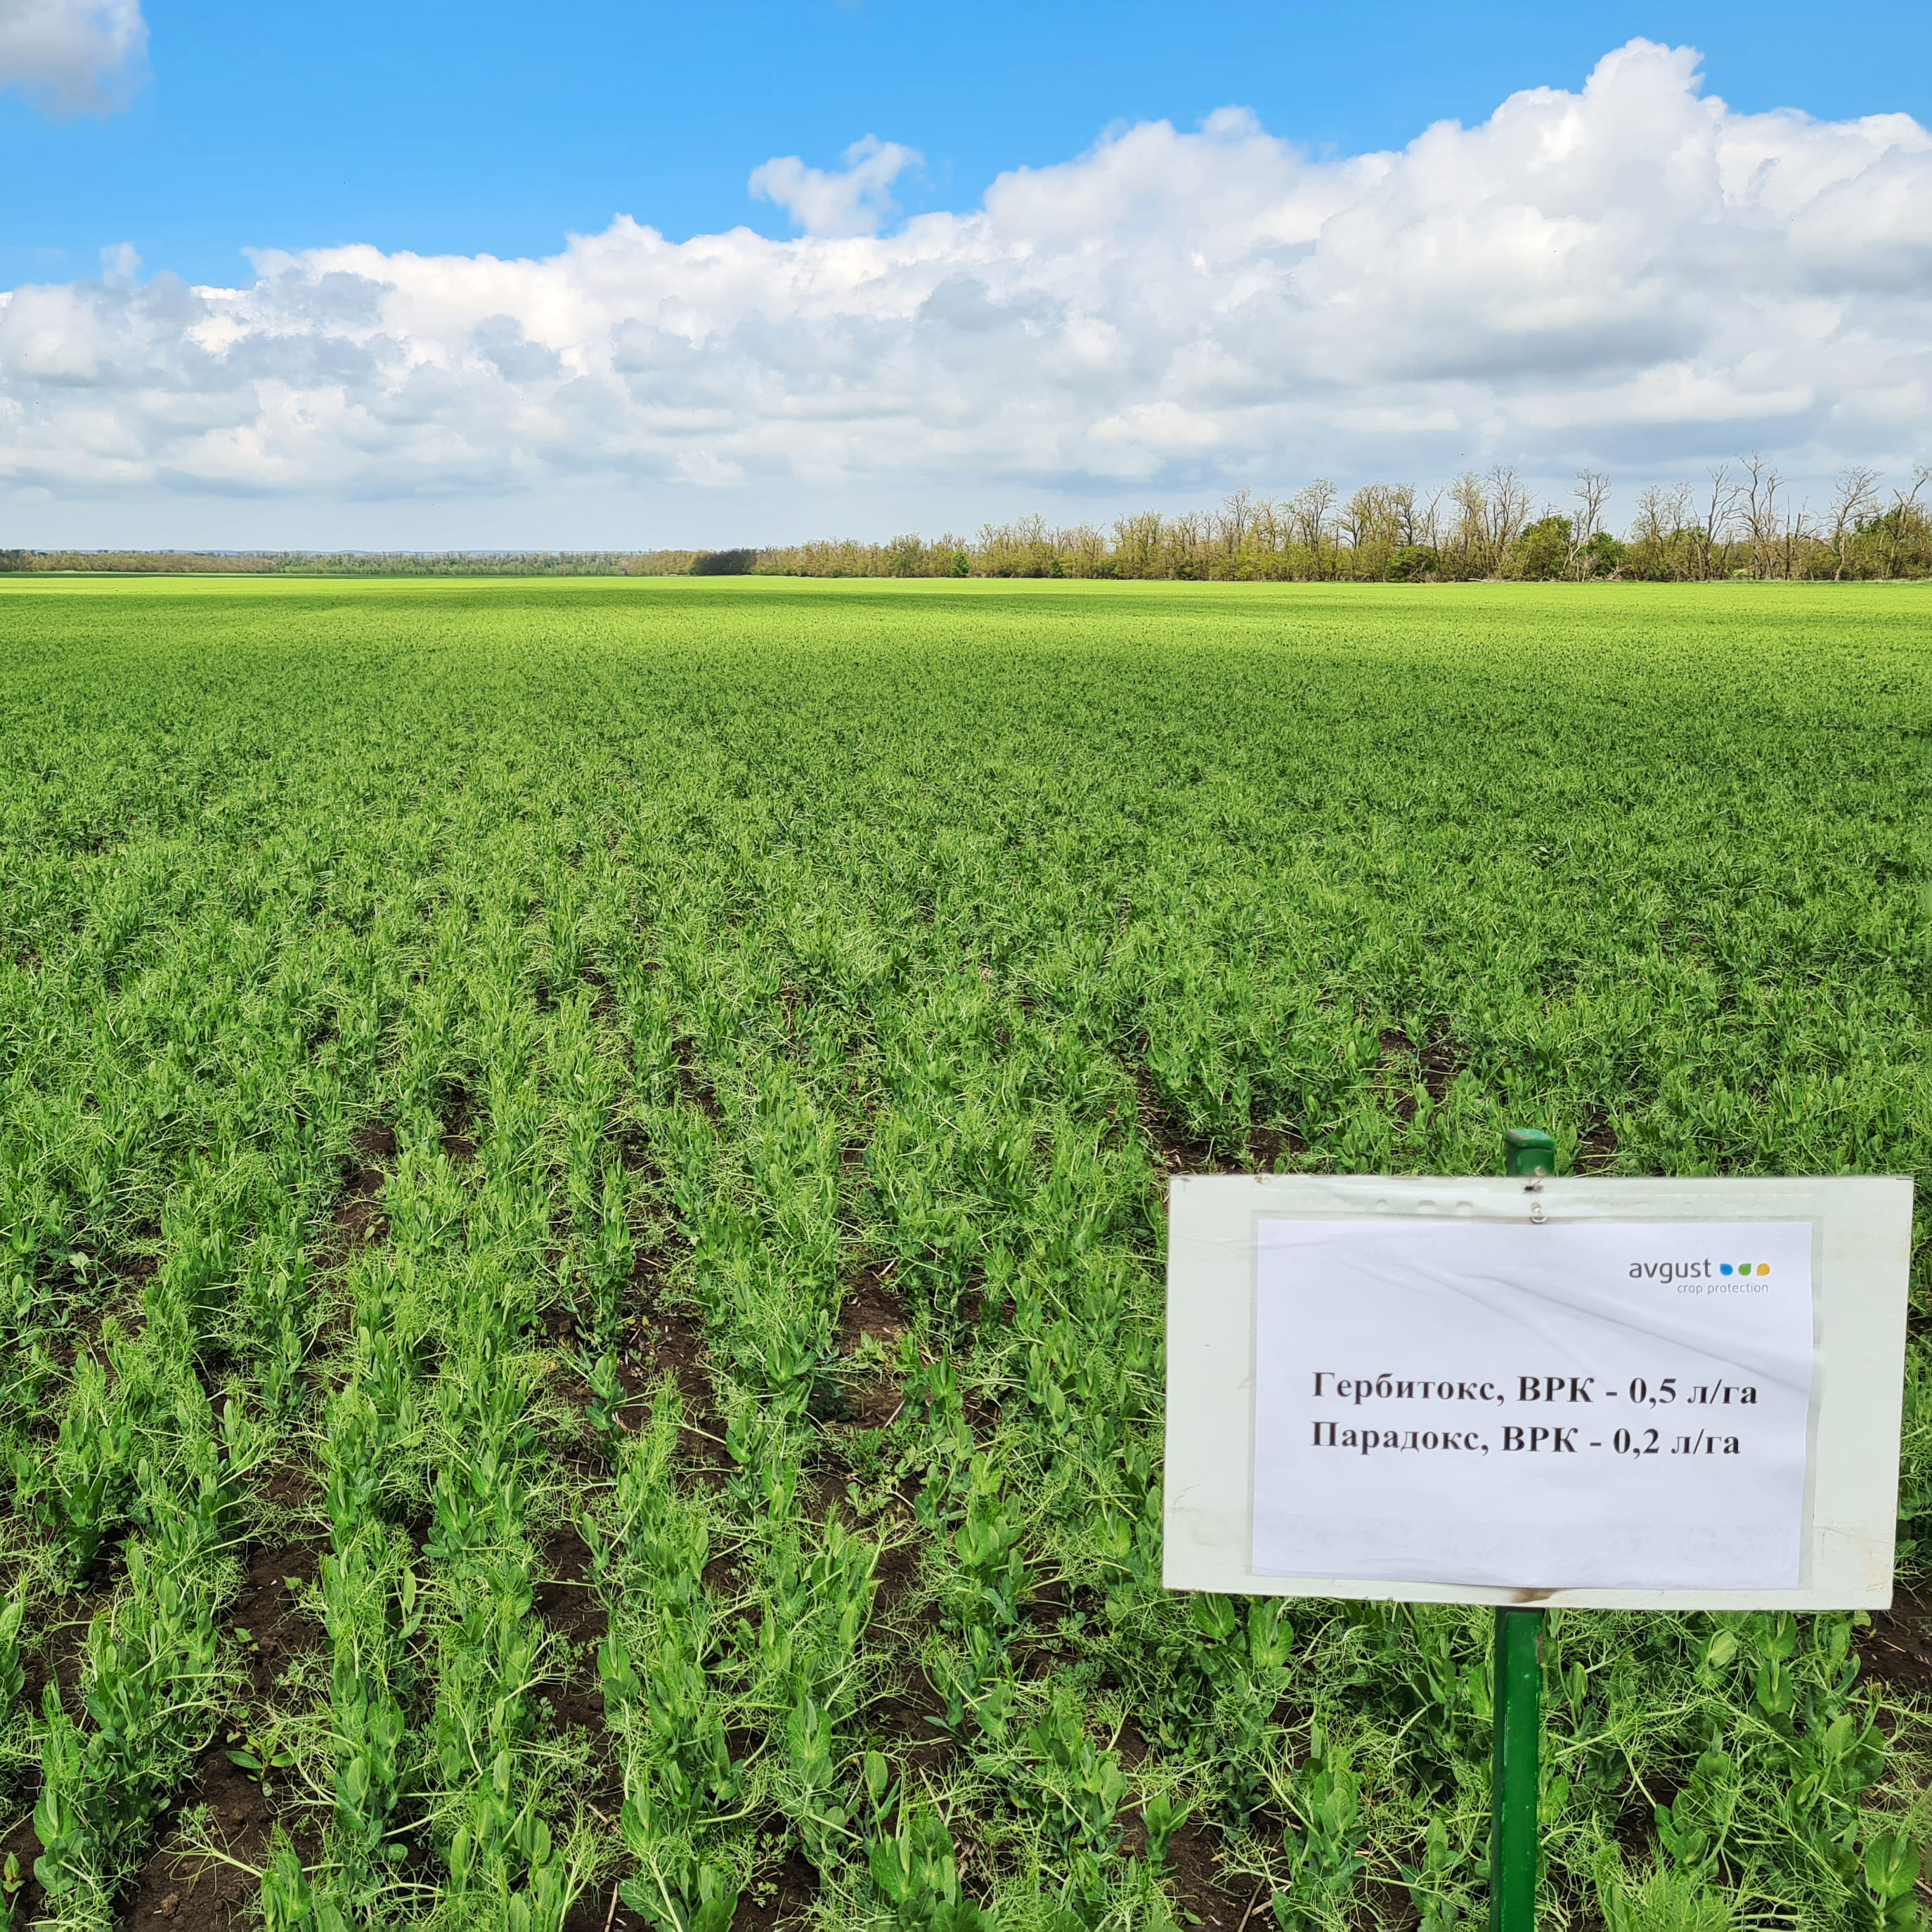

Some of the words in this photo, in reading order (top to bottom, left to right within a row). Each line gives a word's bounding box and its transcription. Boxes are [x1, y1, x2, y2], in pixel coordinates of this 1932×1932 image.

[1629, 1258, 1712, 1284] avgust
[1677, 1284, 1703, 1295] crop
[1708, 1283, 1769, 1295] protection
[1311, 1372, 1505, 1406] Гербитокс,
[1517, 1375, 1595, 1403] ВРК
[1628, 1377, 1677, 1408] 0,5
[1687, 1378, 1758, 1405] л/га
[1311, 1420, 1489, 1455] Парадокс,
[1500, 1425, 1578, 1453] ВРК
[1613, 1427, 1660, 1460] 0,2
[1671, 1429, 1742, 1455] л/га
